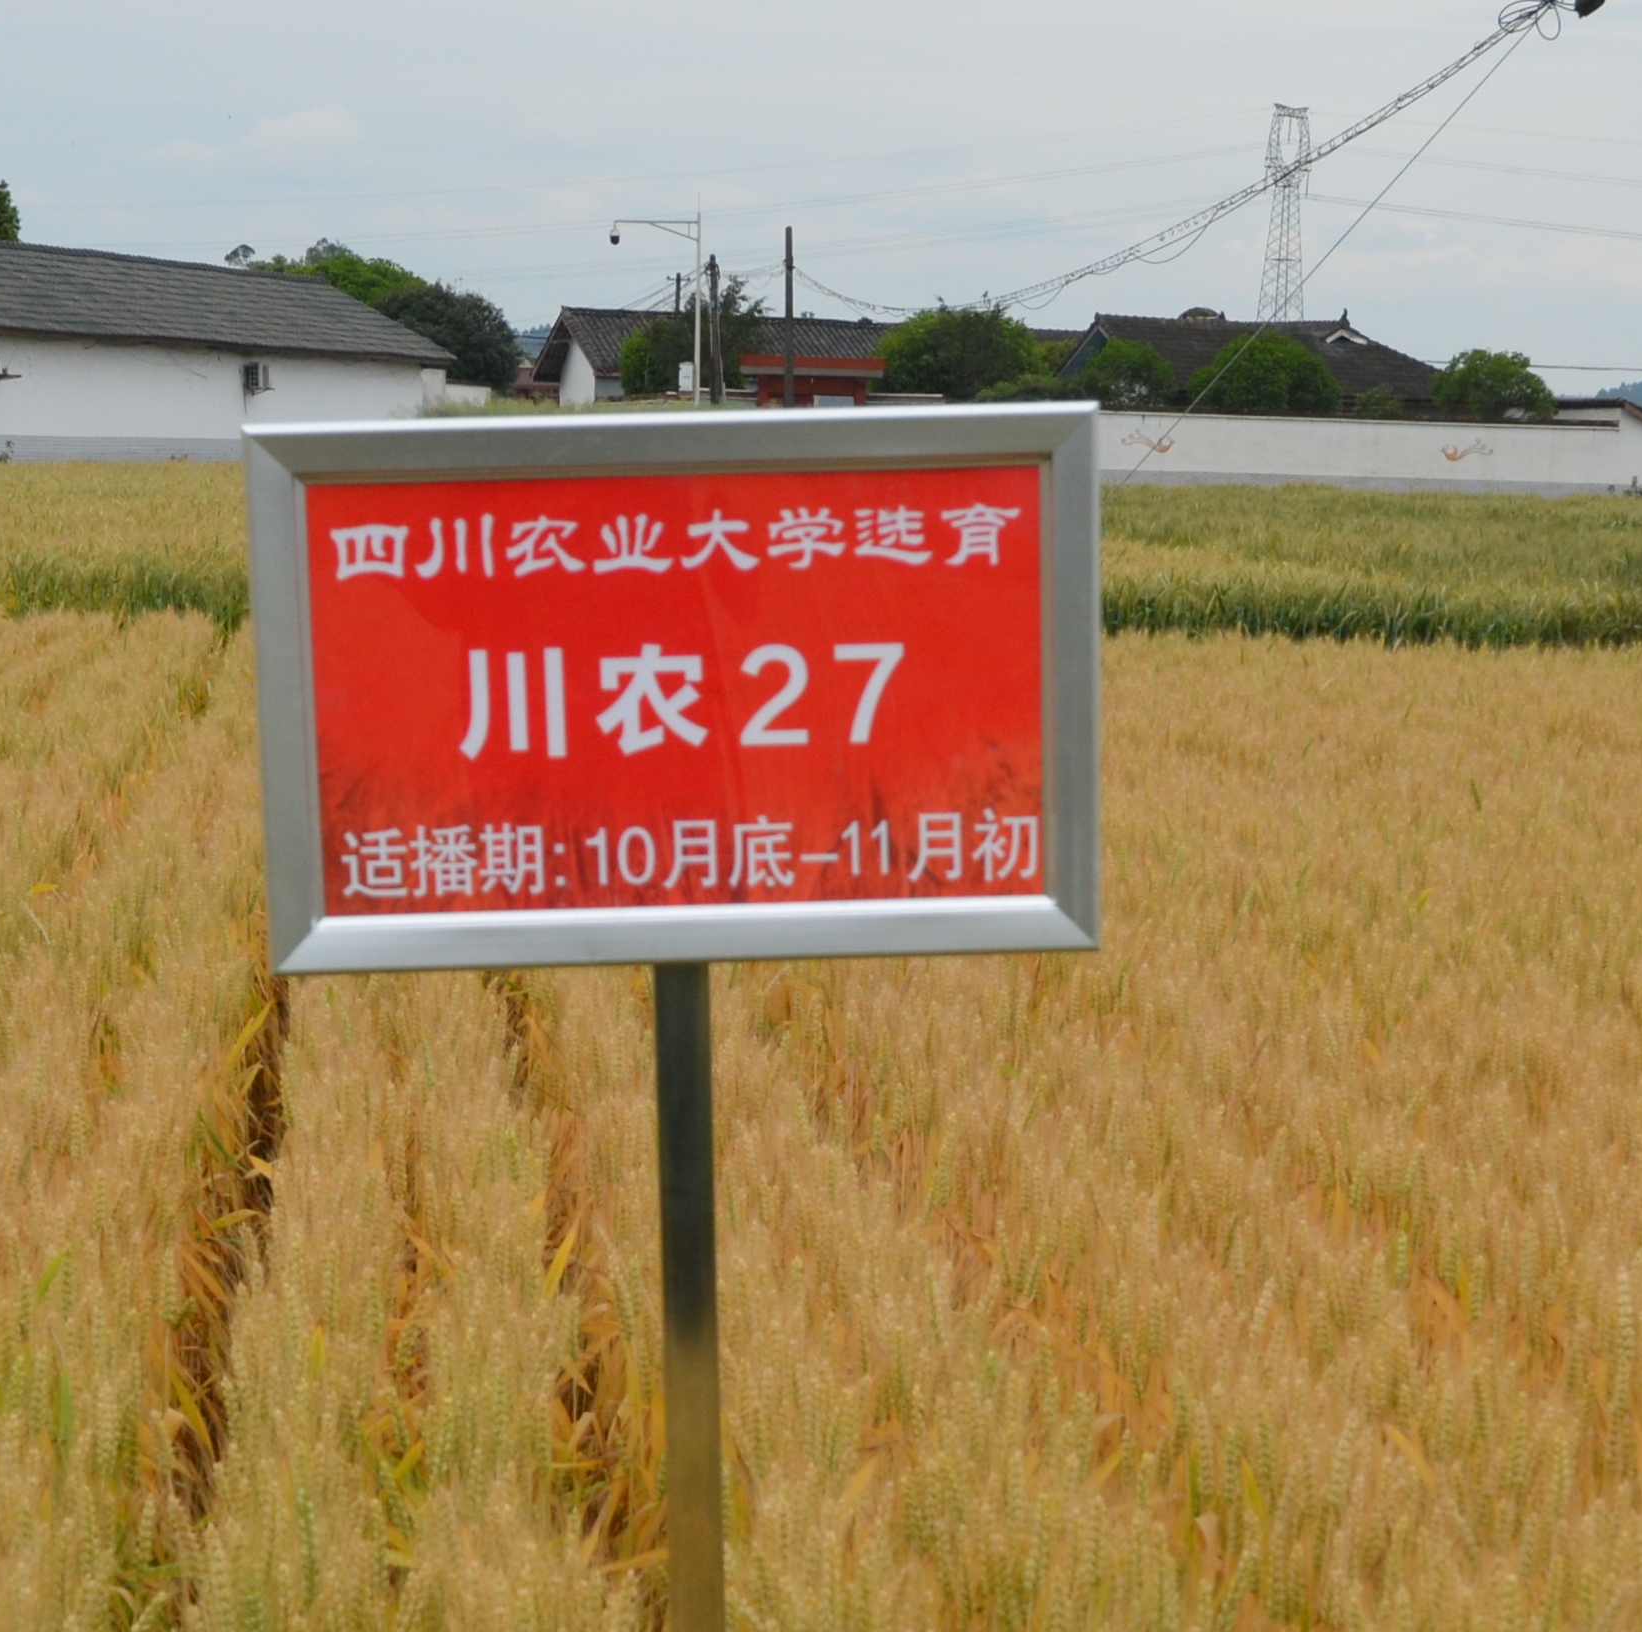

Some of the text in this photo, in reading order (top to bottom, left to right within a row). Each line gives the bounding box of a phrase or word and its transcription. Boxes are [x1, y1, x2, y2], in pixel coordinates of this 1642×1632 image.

[330, 503, 1020, 581] 四川农业大学选育
[460, 643, 904, 760] 川农27
